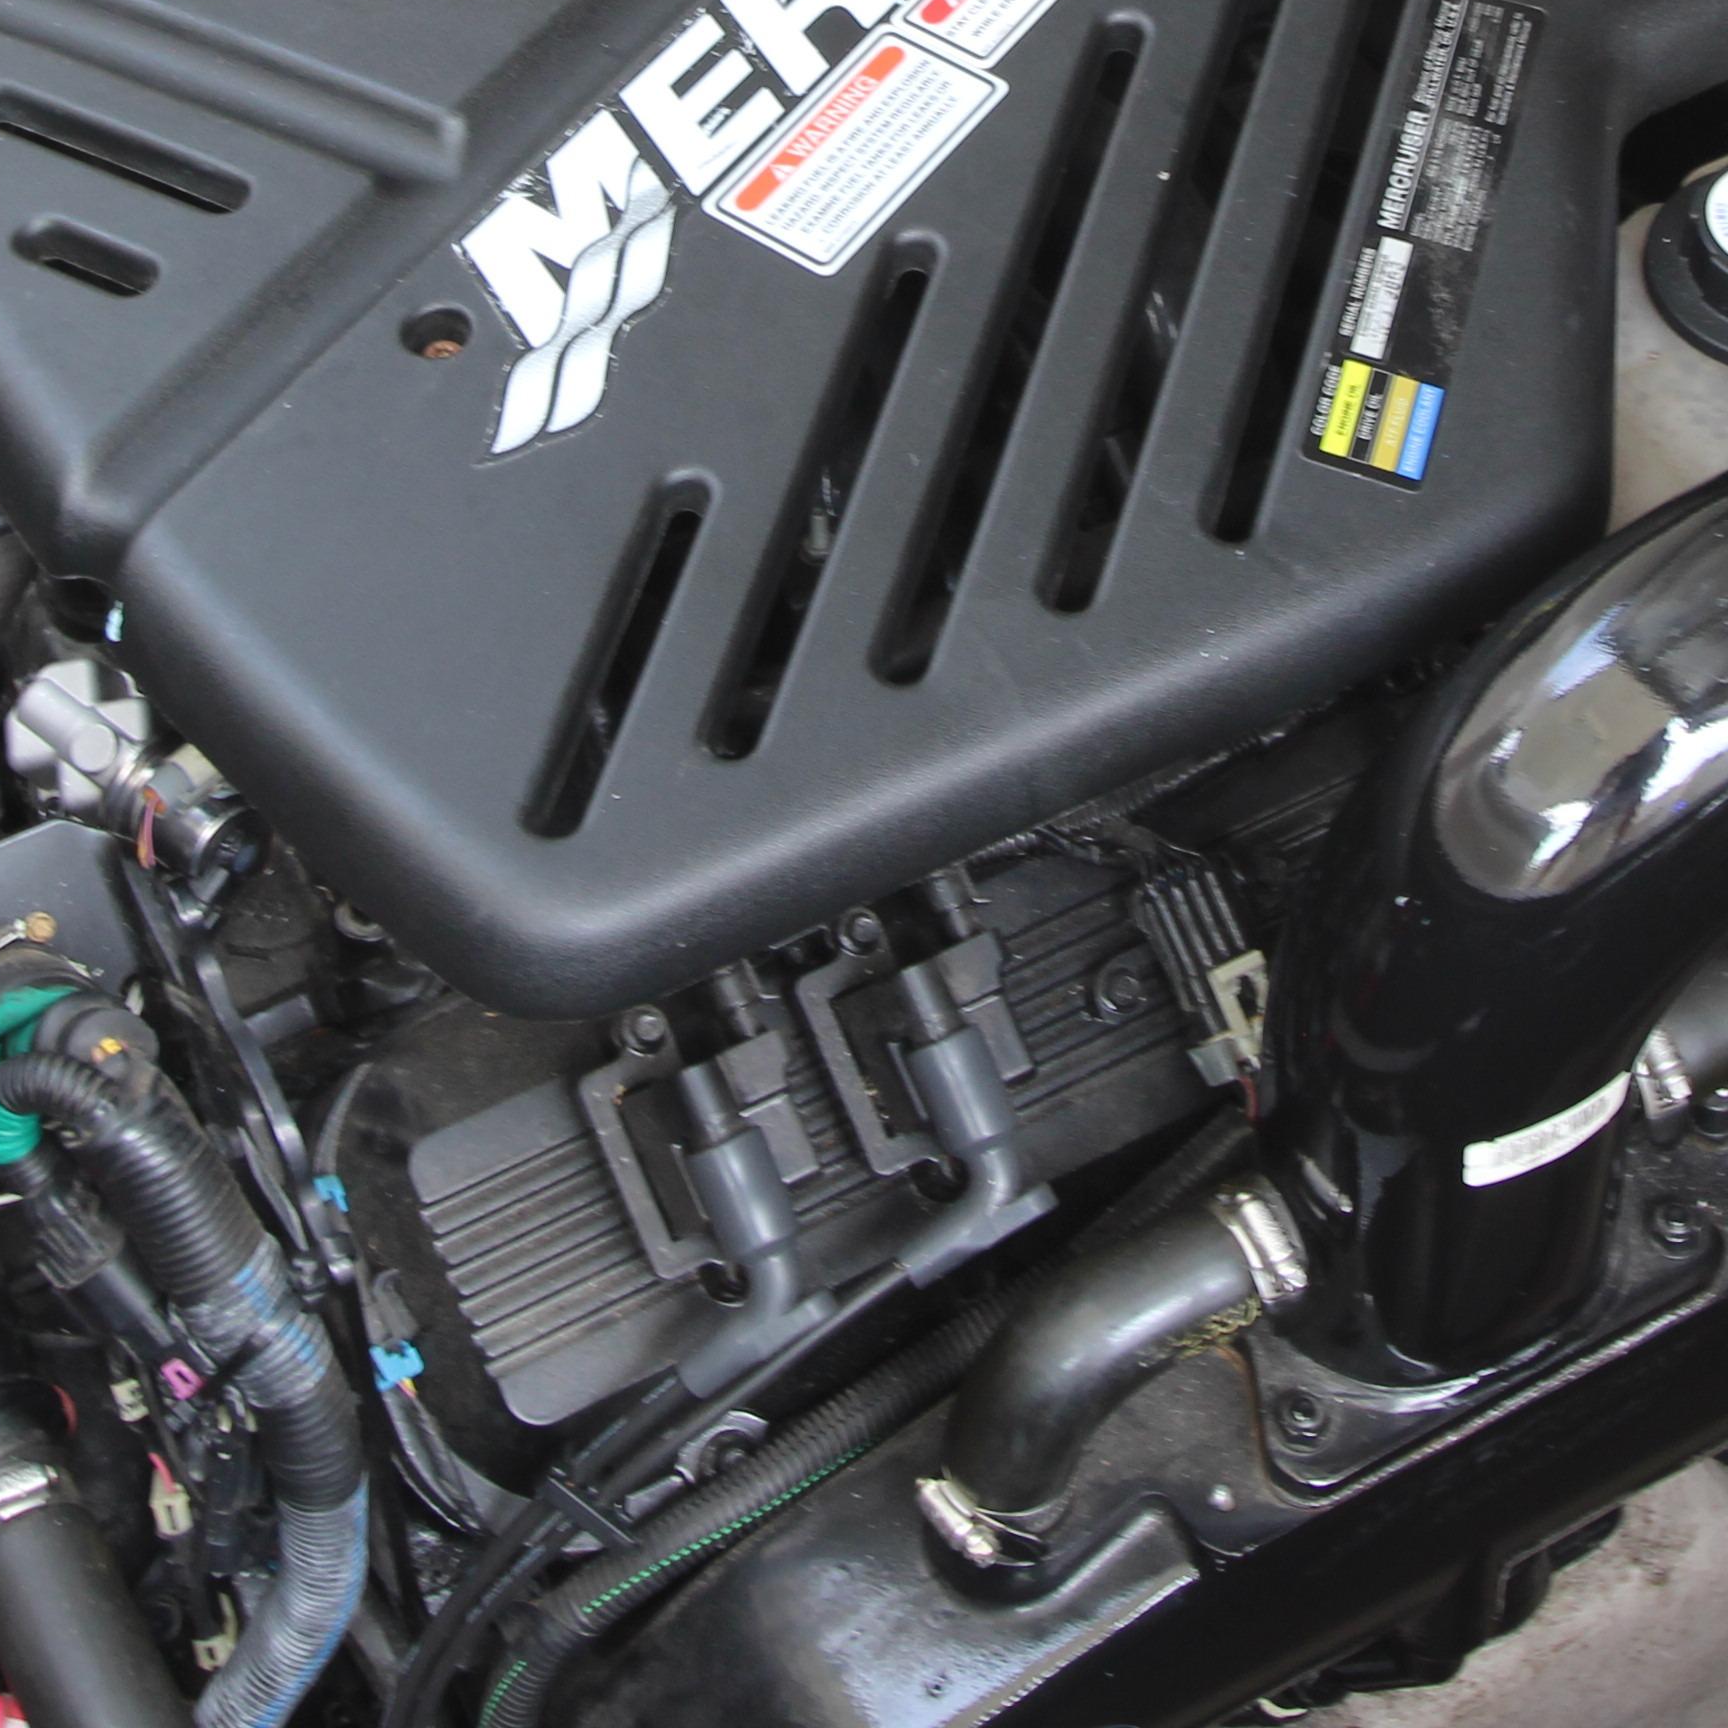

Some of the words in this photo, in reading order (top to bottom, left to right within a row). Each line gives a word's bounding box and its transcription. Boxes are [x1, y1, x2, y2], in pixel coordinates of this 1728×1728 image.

[943, 14, 970, 37] STAY
[969, 9, 1002, 37] WHILE
[762, 184, 807, 227] LEAKING
[801, 162, 829, 187] FUEL
[824, 152, 839, 164] IS
[833, 144, 847, 154] A
[840, 124, 866, 147] FIRE
[860, 105, 886, 126] AND
[879, 58, 932, 107] EXPLOSION
[784, 73, 880, 161] WARNING
[799, 193, 843, 235] EXAMINE
[837, 170, 865, 195] FUEL
[860, 140, 894, 171] TANKS
[887, 122, 912, 142] FOR
[905, 93, 940, 123] LEAKS
[933, 79, 953, 95] OR
[817, 154, 859, 192] INSPECT
[853, 118, 894, 155] SYSTEM
[1376, 108, 1431, 230] MERCRUISER
[820, 180, 878, 236] CORROSION
[871, 168, 889, 182] AT
[882, 139, 917, 171] LEAST
[1349, 245, 1376, 300] NUMBERS
[1338, 298, 1361, 337] SERIAL
[1310, 396, 1333, 436] COLOR
[1322, 363, 1343, 397] CODE
[1334, 400, 1355, 437] ENGINE
[1344, 380, 1360, 401] OIL
[1365, 390, 1382, 412] OIL
[1357, 410, 1377, 441] DRIVE
[1403, 430, 1427, 474] ENGINE
[1415, 386, 1439, 432] COOLANT
